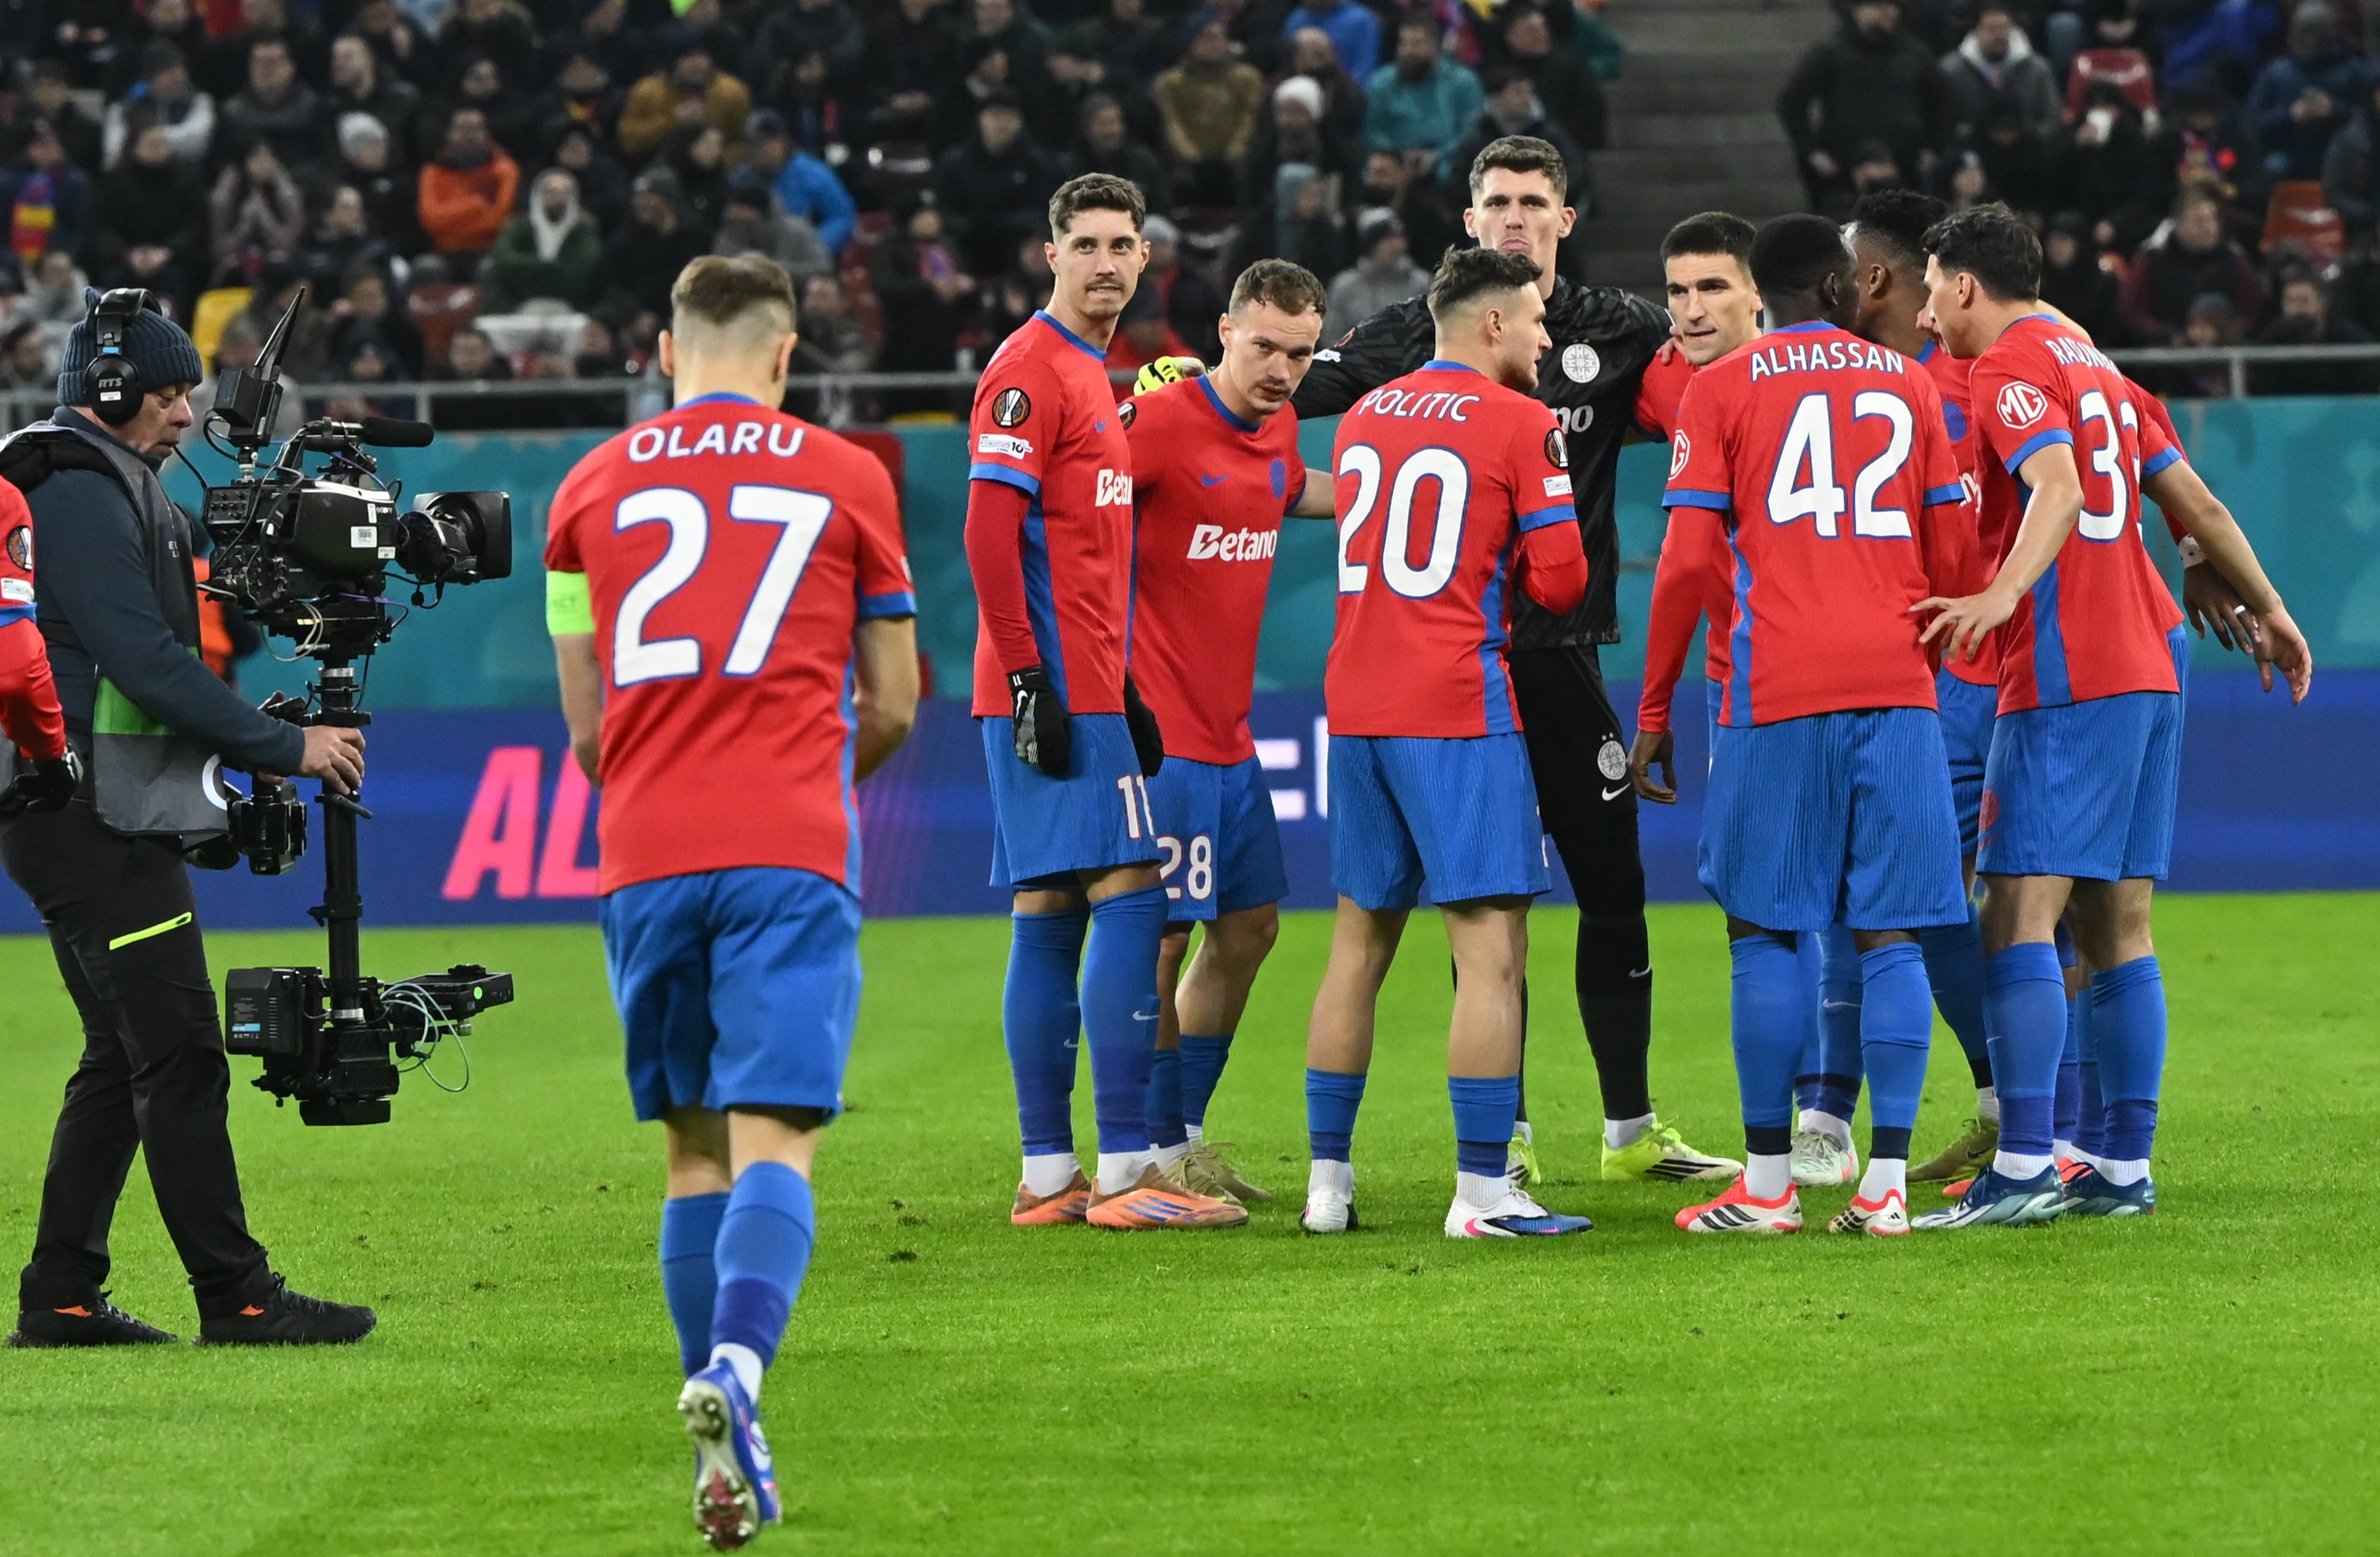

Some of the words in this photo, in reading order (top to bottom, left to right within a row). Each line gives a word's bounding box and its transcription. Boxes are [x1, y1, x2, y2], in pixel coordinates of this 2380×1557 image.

[98, 377, 122, 388] RTS
[1751, 342, 1904, 383] ALHASSAN
[1357, 388, 1482, 422] POLITIC
[2000, 384, 2043, 425] MG
[628, 421, 805, 463] OLARU
[1766, 389, 1915, 540] 42
[1338, 442, 1472, 601] 20
[1186, 524, 1278, 562] Betano
[613, 482, 835, 691] 27
[1156, 834, 1212, 900] 28
